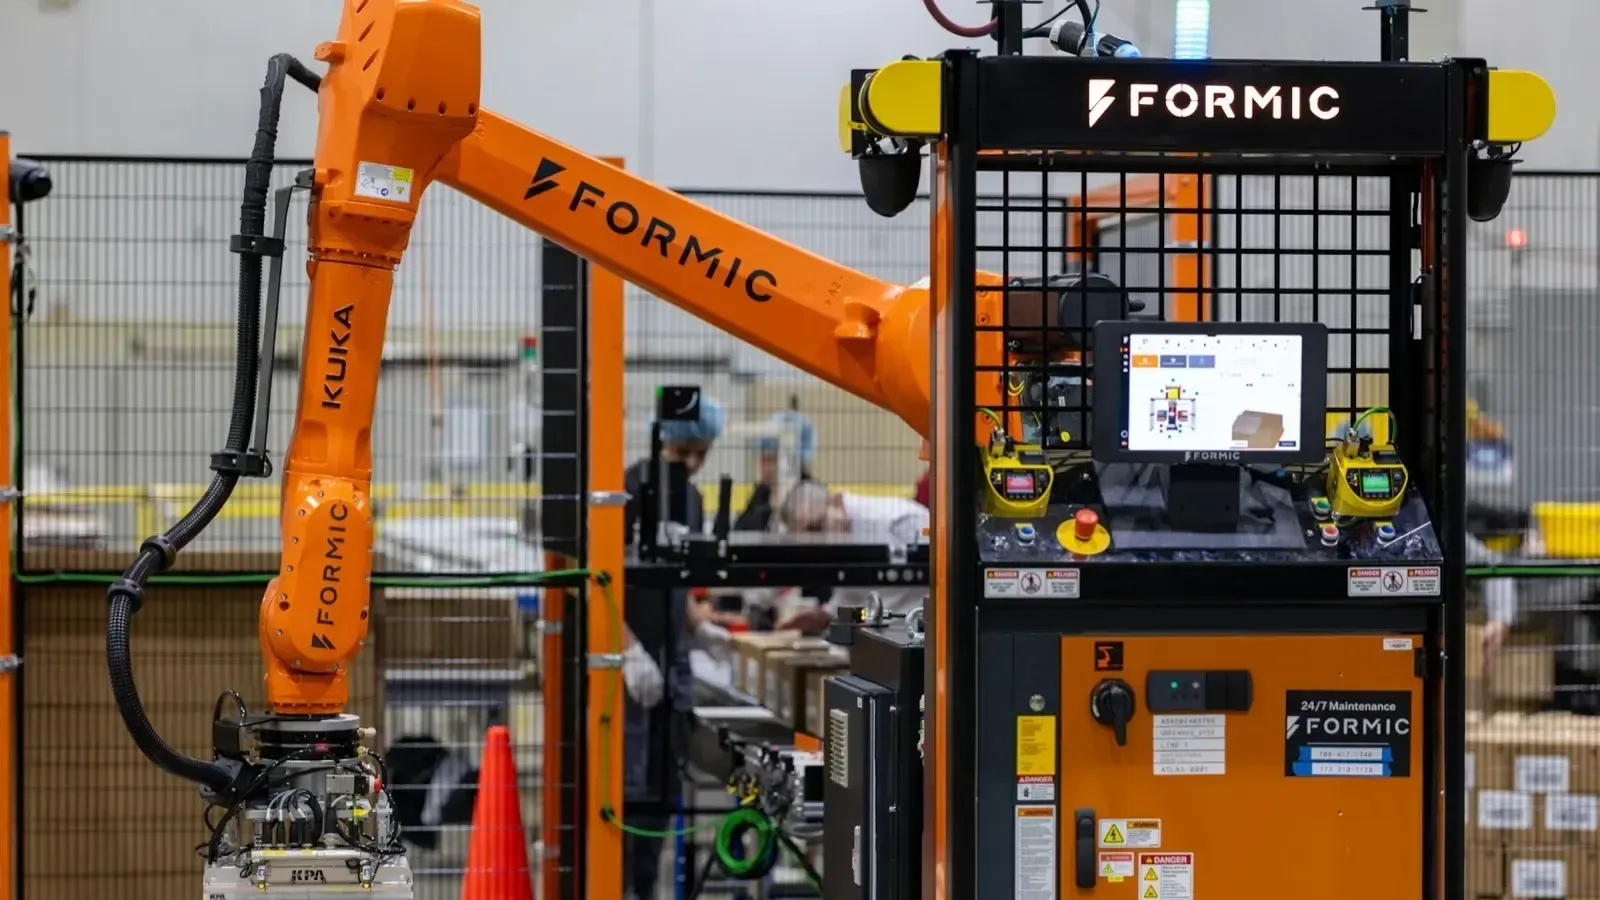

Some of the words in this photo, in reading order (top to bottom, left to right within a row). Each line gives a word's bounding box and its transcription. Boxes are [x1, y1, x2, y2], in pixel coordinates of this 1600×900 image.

[1130, 83, 1340, 120] FORMIC
[568, 180, 778, 303] FORMIC
[321, 303, 355, 409] KUKA
[1193, 451, 1241, 461] FORMIC
[316, 502, 349, 626] FORMIC
[1301, 700, 1328, 712] 24/7
[1329, 701, 1396, 712] Maintenance
[1306, 717, 1410, 735] FORMIC
[1025, 775, 1053, 783] DANGER
[1153, 856, 1187, 864] DANGER
[291, 869, 325, 882] KPA
